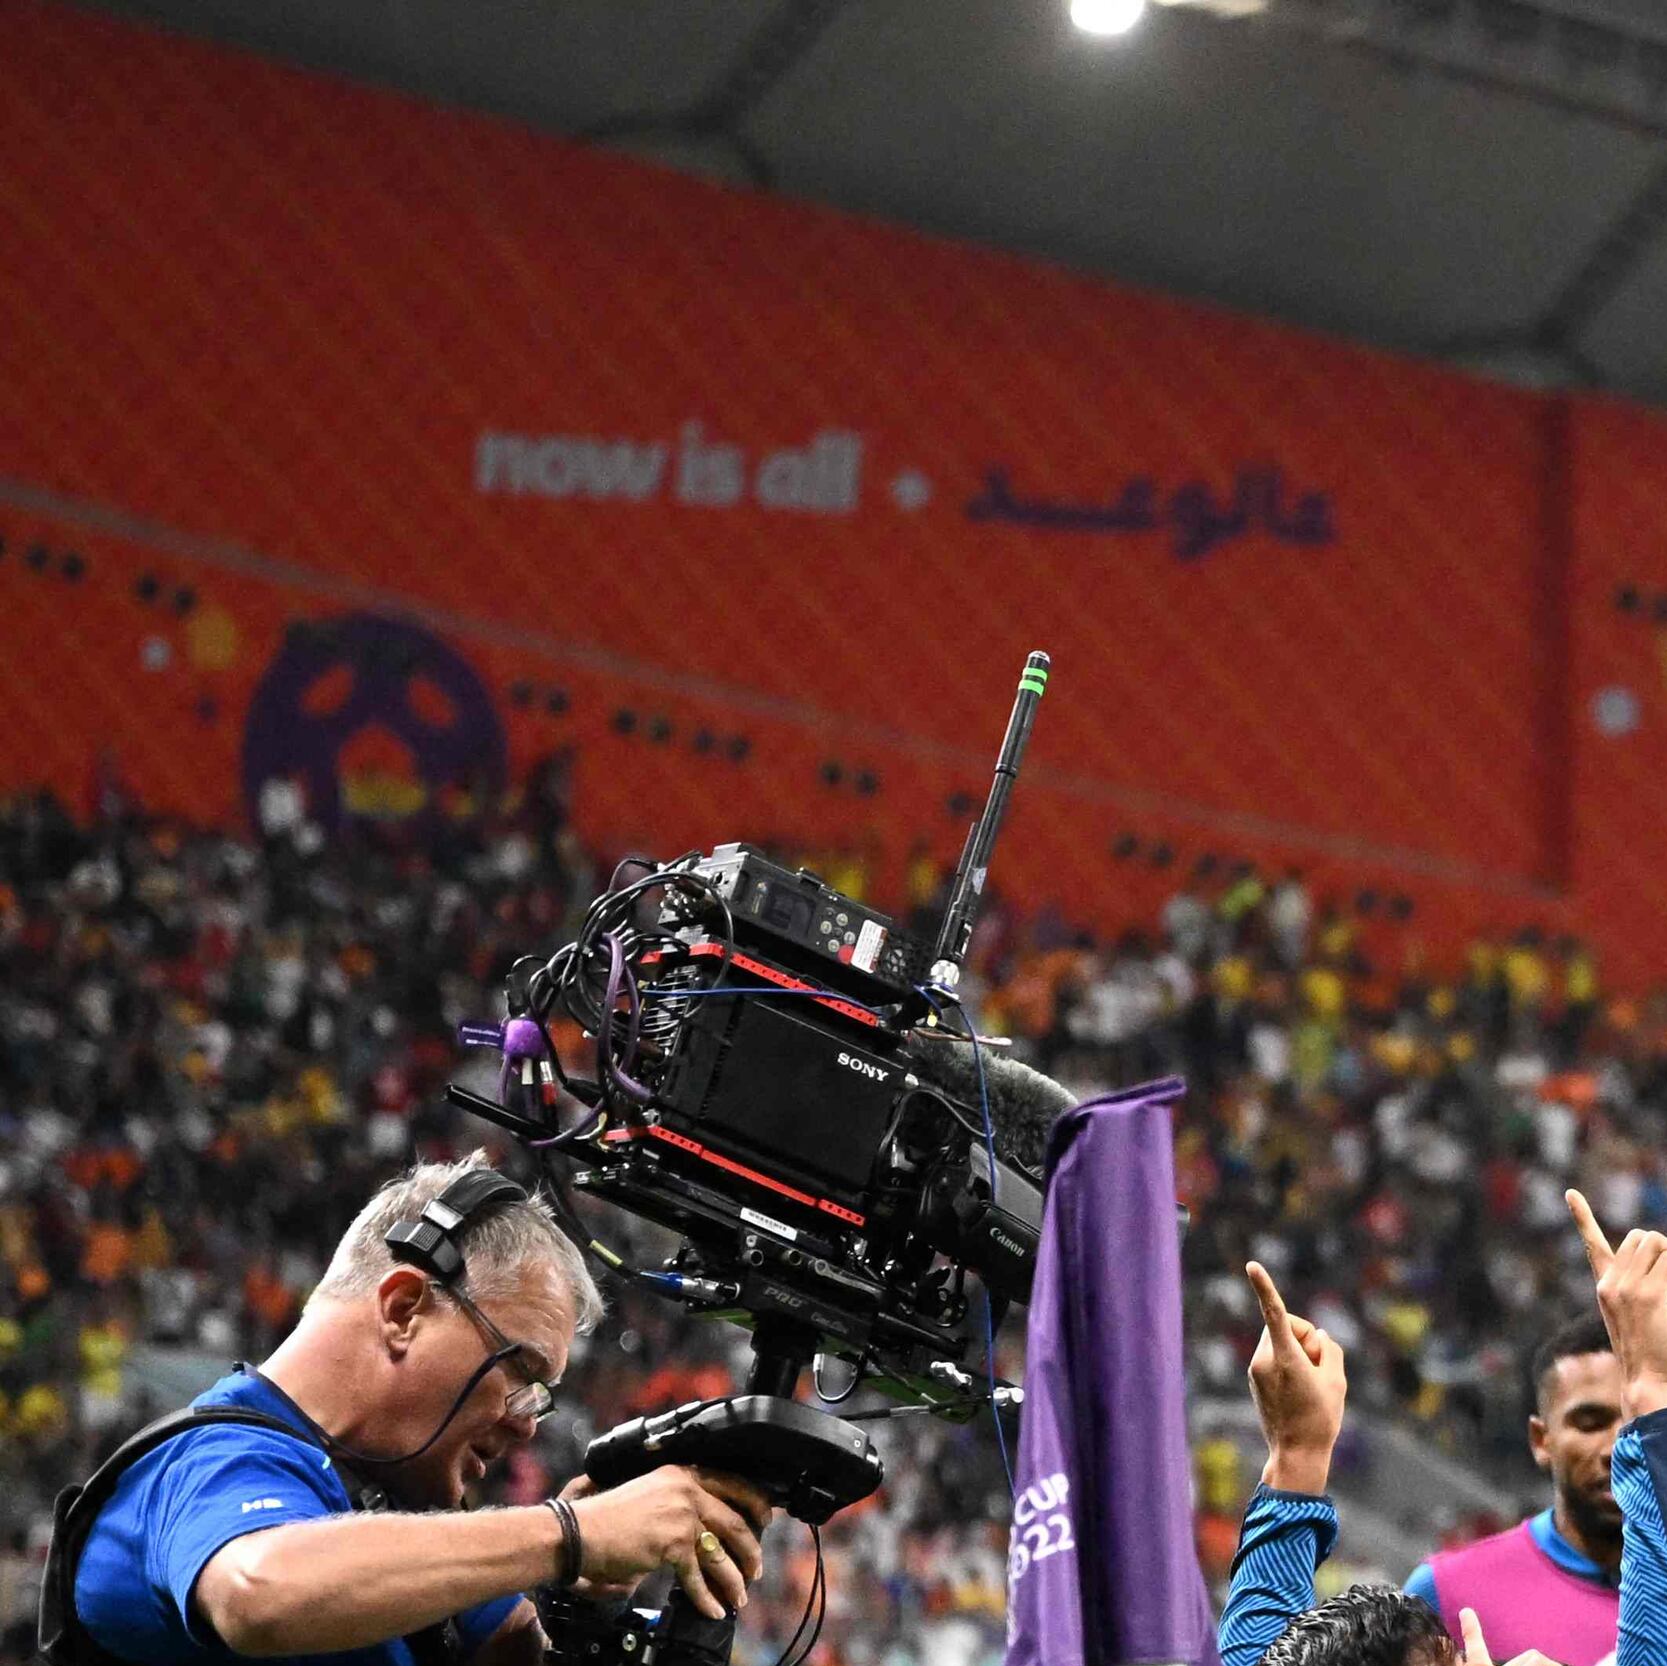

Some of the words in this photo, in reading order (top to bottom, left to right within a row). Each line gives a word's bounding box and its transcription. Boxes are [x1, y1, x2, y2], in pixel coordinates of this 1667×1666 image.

[478, 430, 664, 500] now
[674, 418, 744, 507] is
[759, 429, 860, 512] all
[837, 1052, 889, 1082] SONY
[990, 1227, 1025, 1257] Canon
